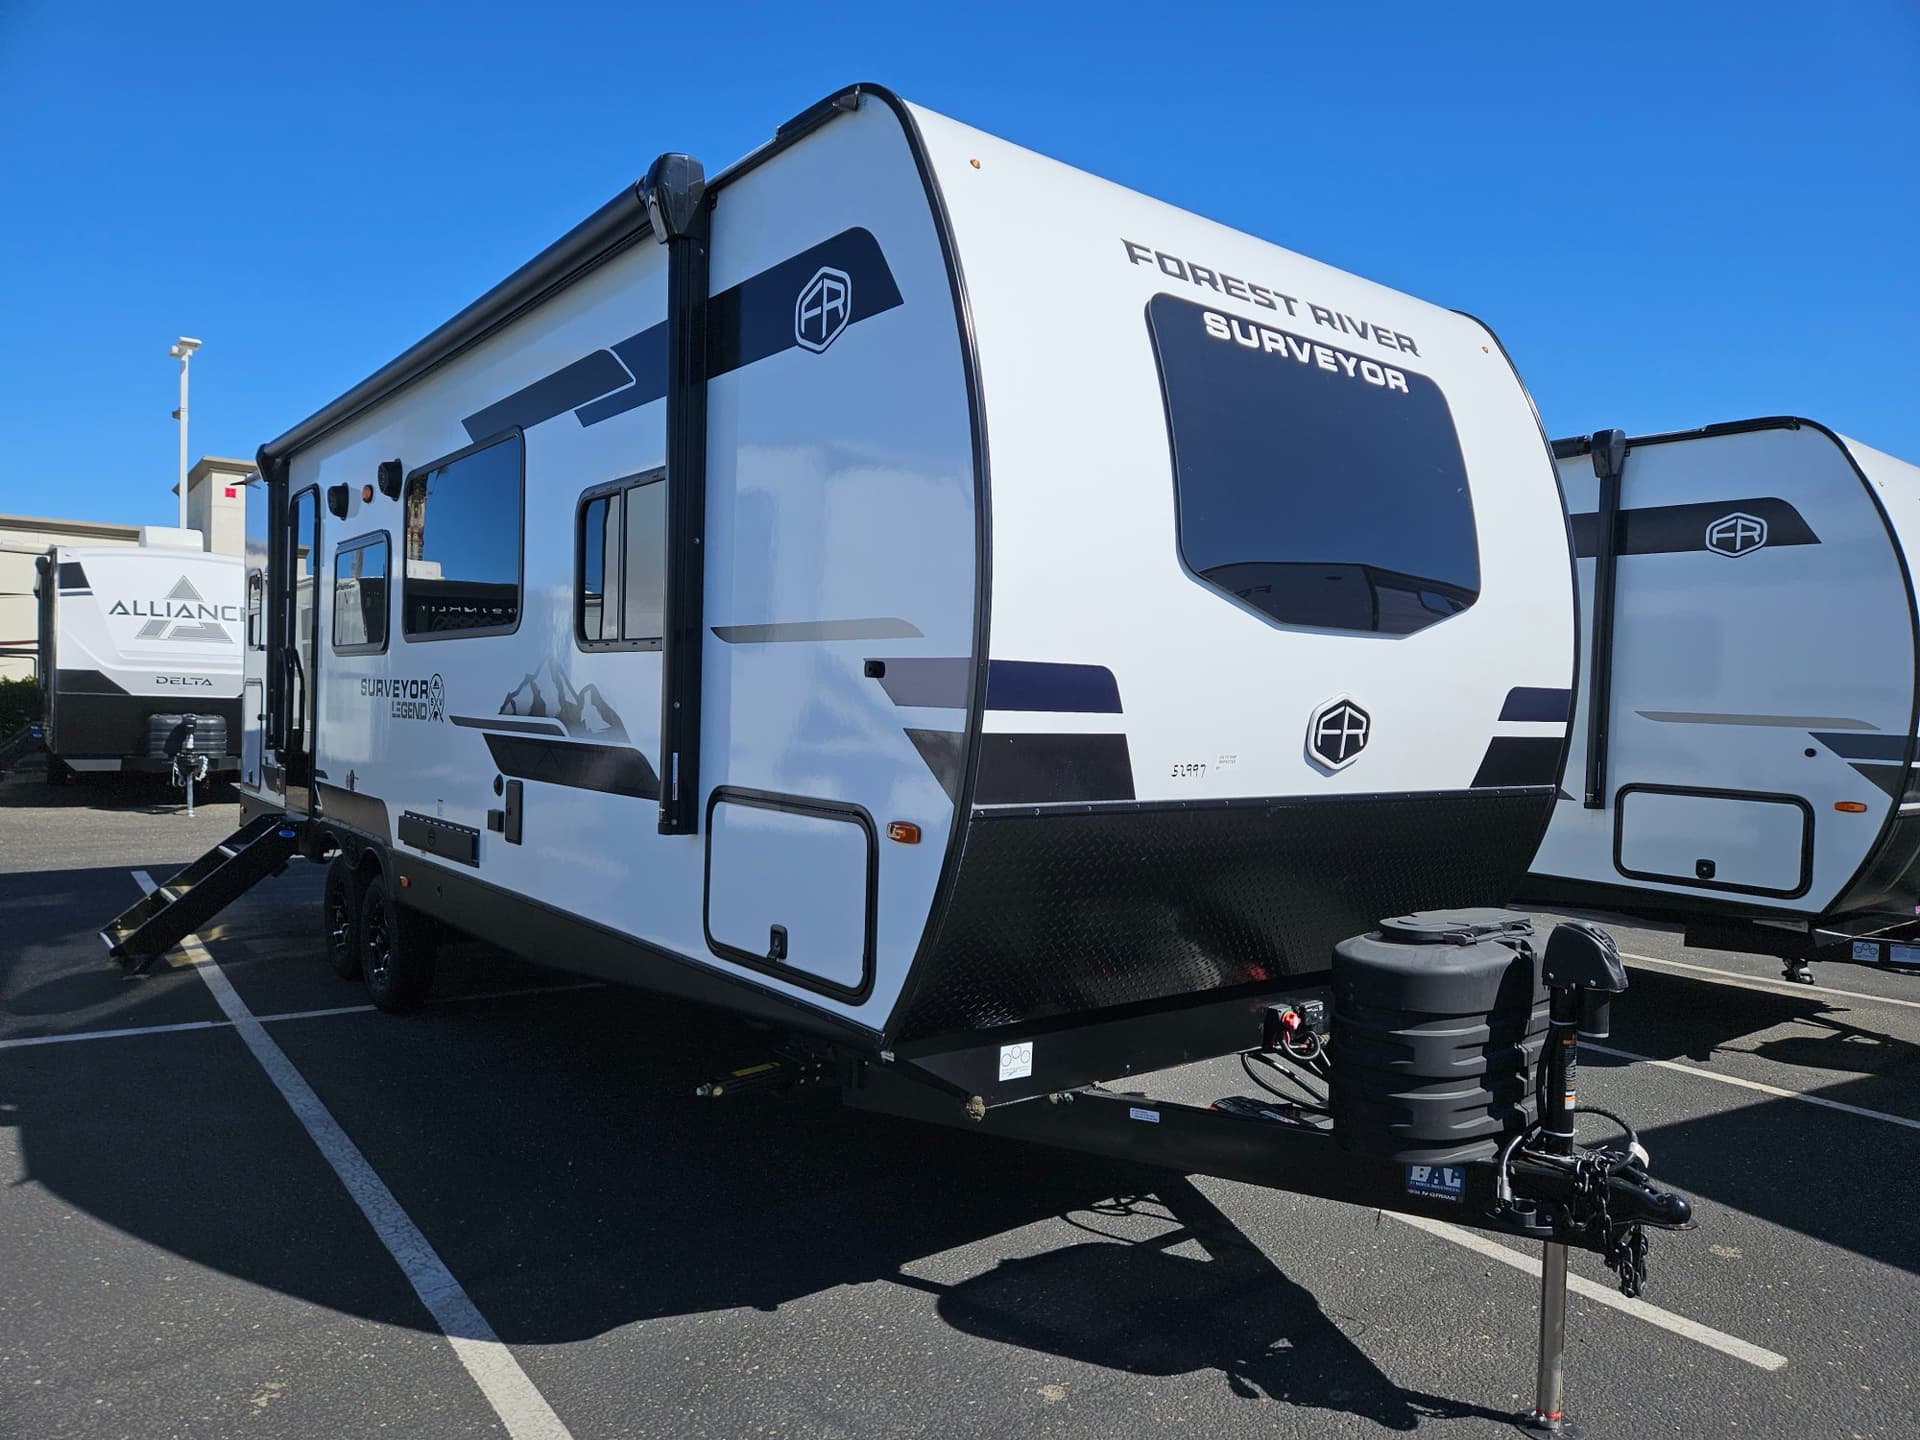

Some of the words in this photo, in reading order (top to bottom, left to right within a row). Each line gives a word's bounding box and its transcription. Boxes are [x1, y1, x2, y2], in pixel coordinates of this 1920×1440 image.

[1120, 238, 1299, 317] FOREST
[1306, 301, 1423, 358] RIVER
[1202, 310, 1410, 394] SURVEYOR
[155, 676, 213, 687] DELTA
[361, 678, 429, 699] SURVEYOR
[391, 701, 428, 721] LEGEND
